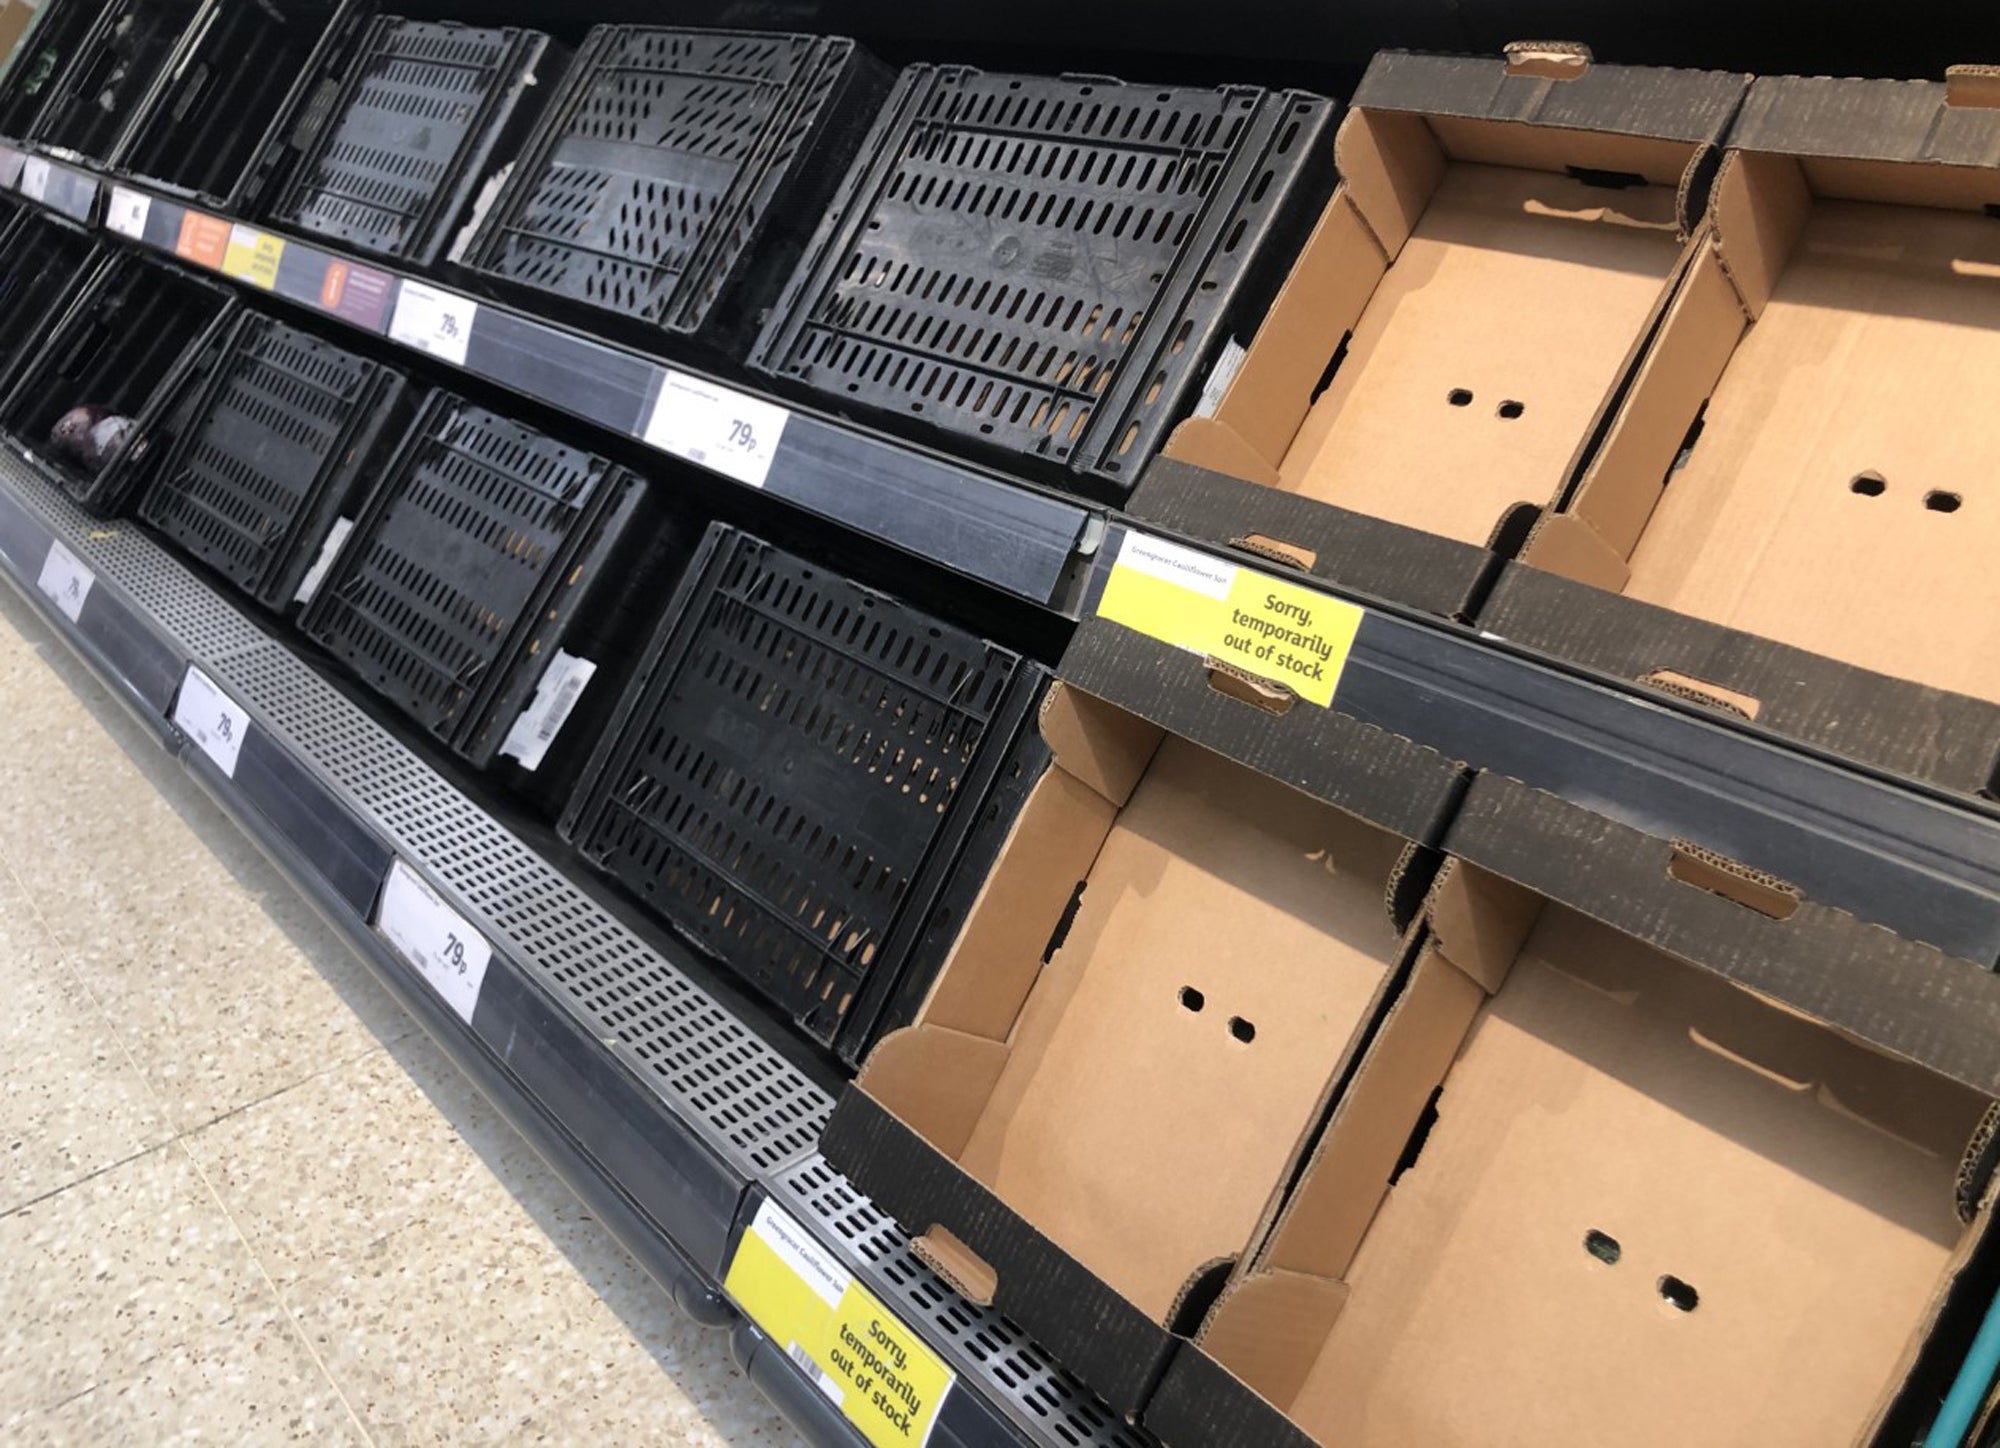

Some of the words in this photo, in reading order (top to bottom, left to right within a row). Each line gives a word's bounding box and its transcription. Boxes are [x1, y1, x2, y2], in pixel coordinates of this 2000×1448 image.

[728, 419, 757, 453] 79p
[1264, 594, 1312, 627] Sorry,
[1224, 634, 1252, 654] out
[1255, 645, 1276, 661] of
[1276, 653, 1324, 682] stock
[1232, 608, 1333, 662] temporarily
[217, 712, 232, 743] 79p
[443, 932, 468, 976] 79p
[868, 1319, 907, 1371] Sorry,
[831, 1349, 854, 1378] out
[855, 1374, 874, 1394] of
[872, 1390, 912, 1437] stock
[840, 1323, 921, 1416] temporarily
